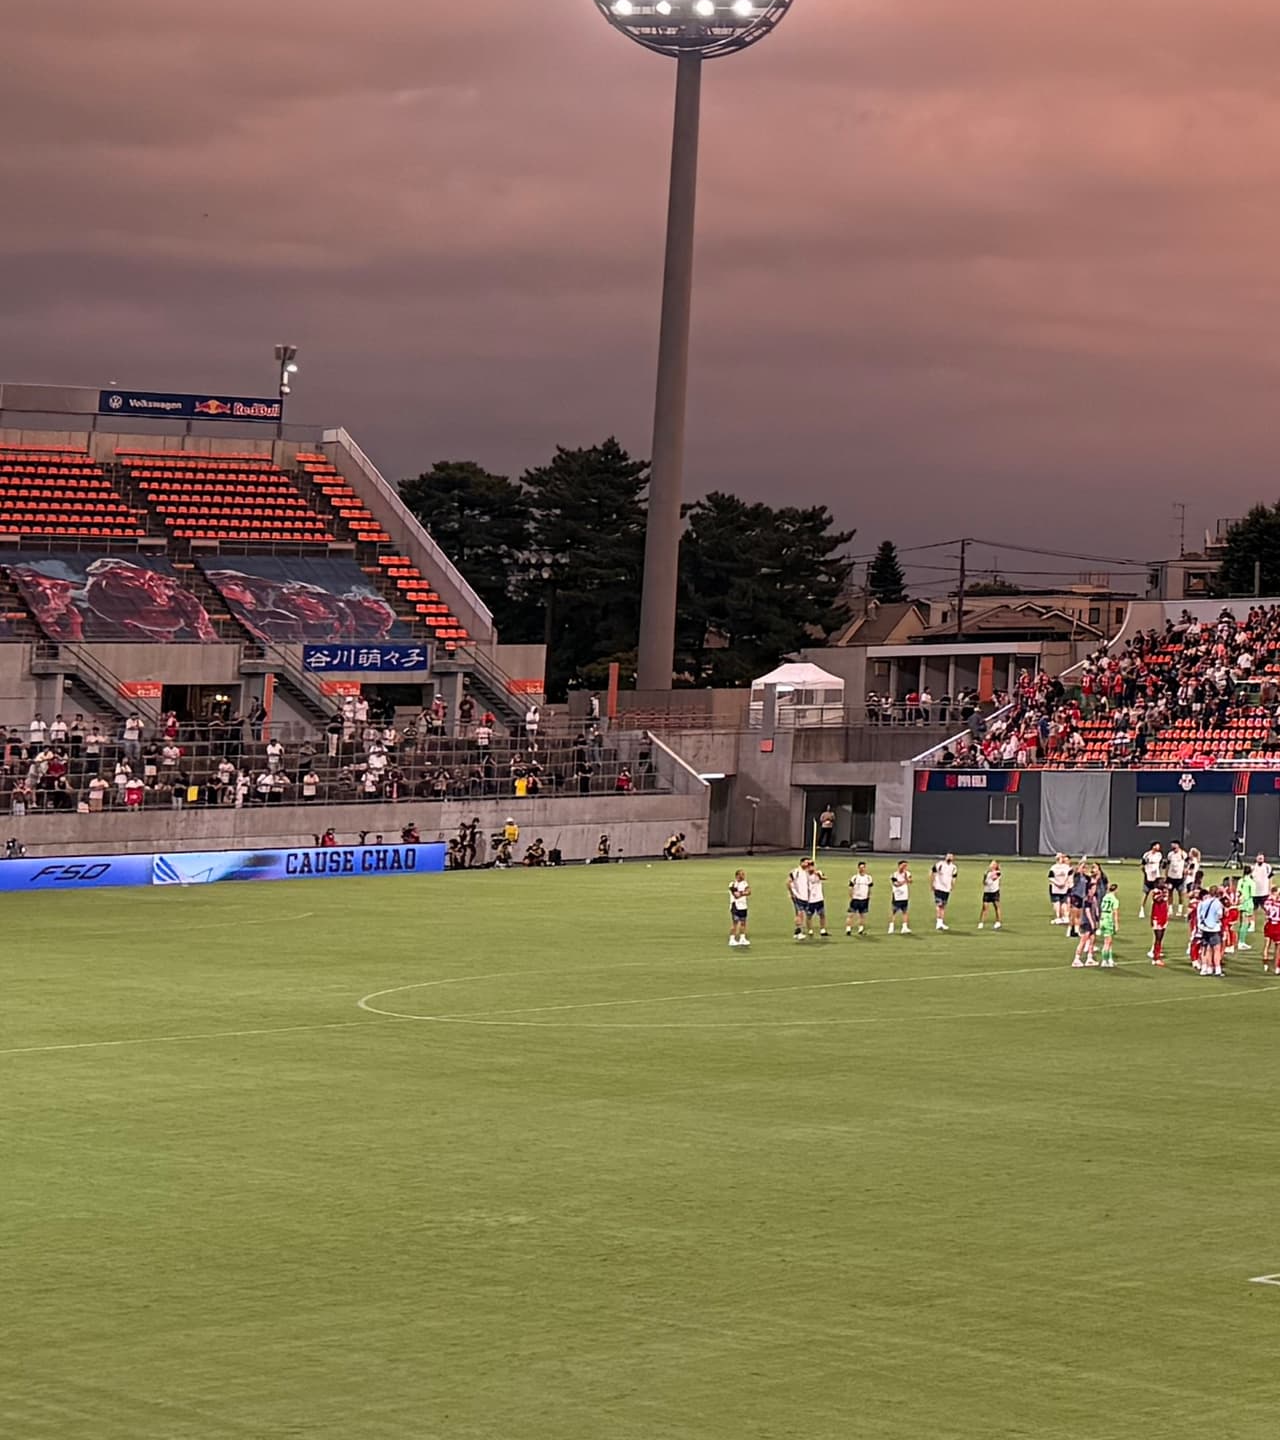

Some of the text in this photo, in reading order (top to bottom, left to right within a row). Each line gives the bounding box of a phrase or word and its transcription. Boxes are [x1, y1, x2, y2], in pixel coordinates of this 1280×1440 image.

[129, 399, 182, 410] Volkswagen
[306, 649, 425, 668] 谷川萌々子
[286, 848, 417, 875] CAUSE CHAO
